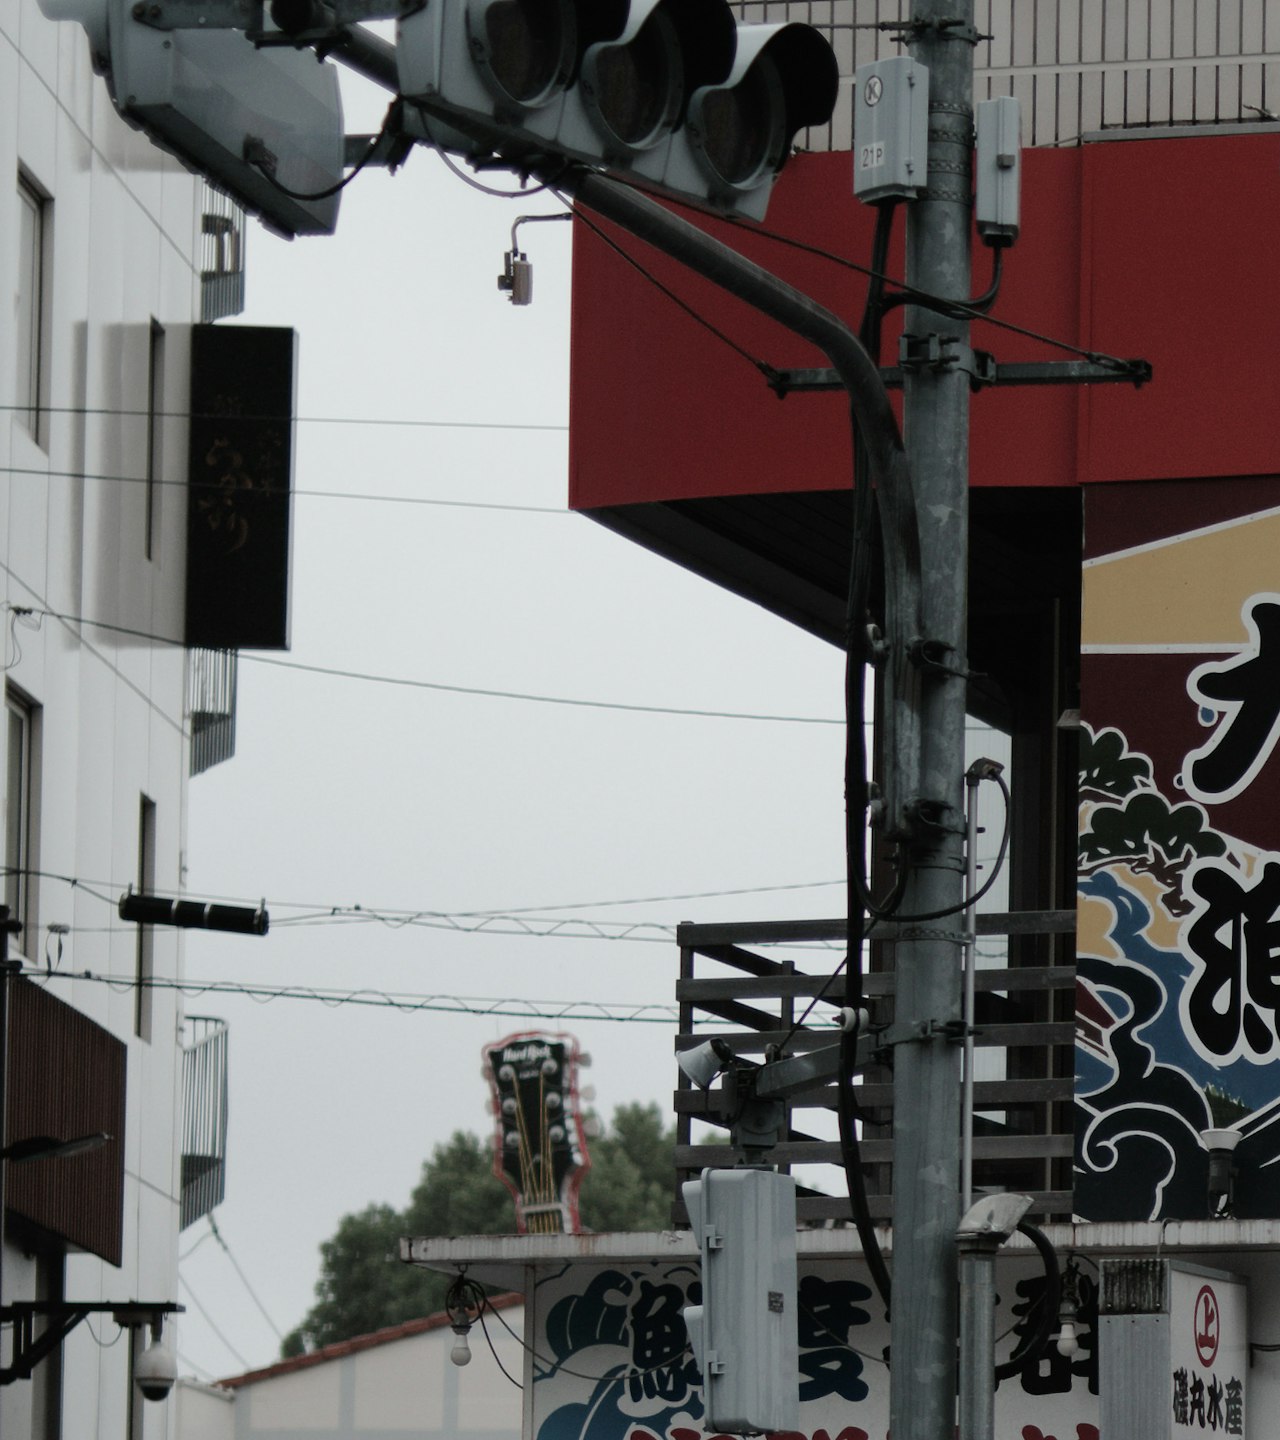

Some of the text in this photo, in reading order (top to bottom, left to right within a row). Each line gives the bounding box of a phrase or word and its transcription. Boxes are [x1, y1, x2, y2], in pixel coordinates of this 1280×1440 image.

[630, 1276, 1100, 1402] 鮮度群
[1173, 1367, 1243, 1435] 磯丸水産
